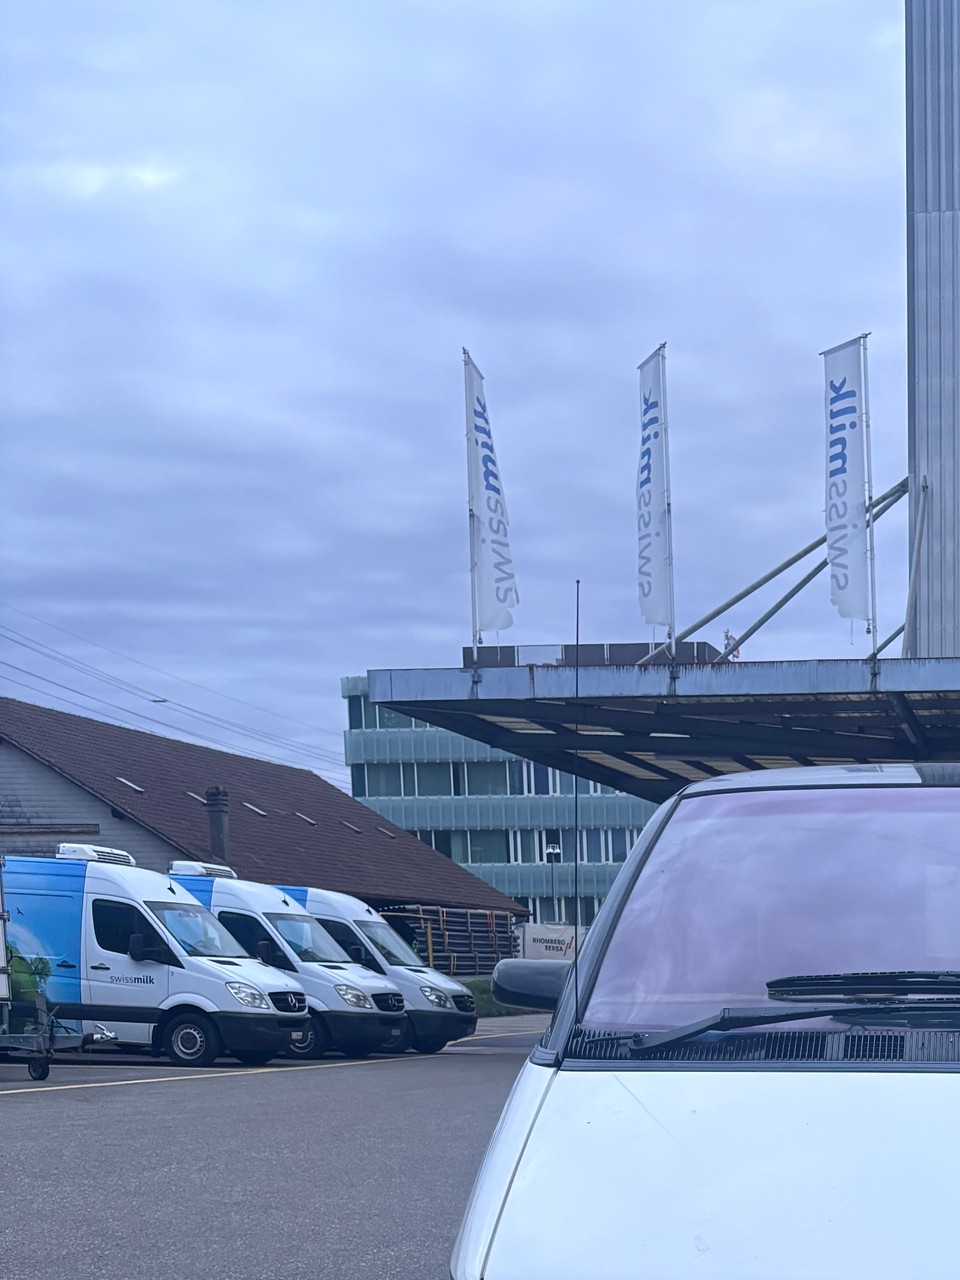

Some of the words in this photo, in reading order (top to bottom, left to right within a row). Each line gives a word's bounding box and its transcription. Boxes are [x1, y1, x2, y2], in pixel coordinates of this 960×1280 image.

[532, 937, 566, 946] RHOMBERG
[544, 944, 564, 952] SERSA
[109, 973, 155, 985] swissmilk
